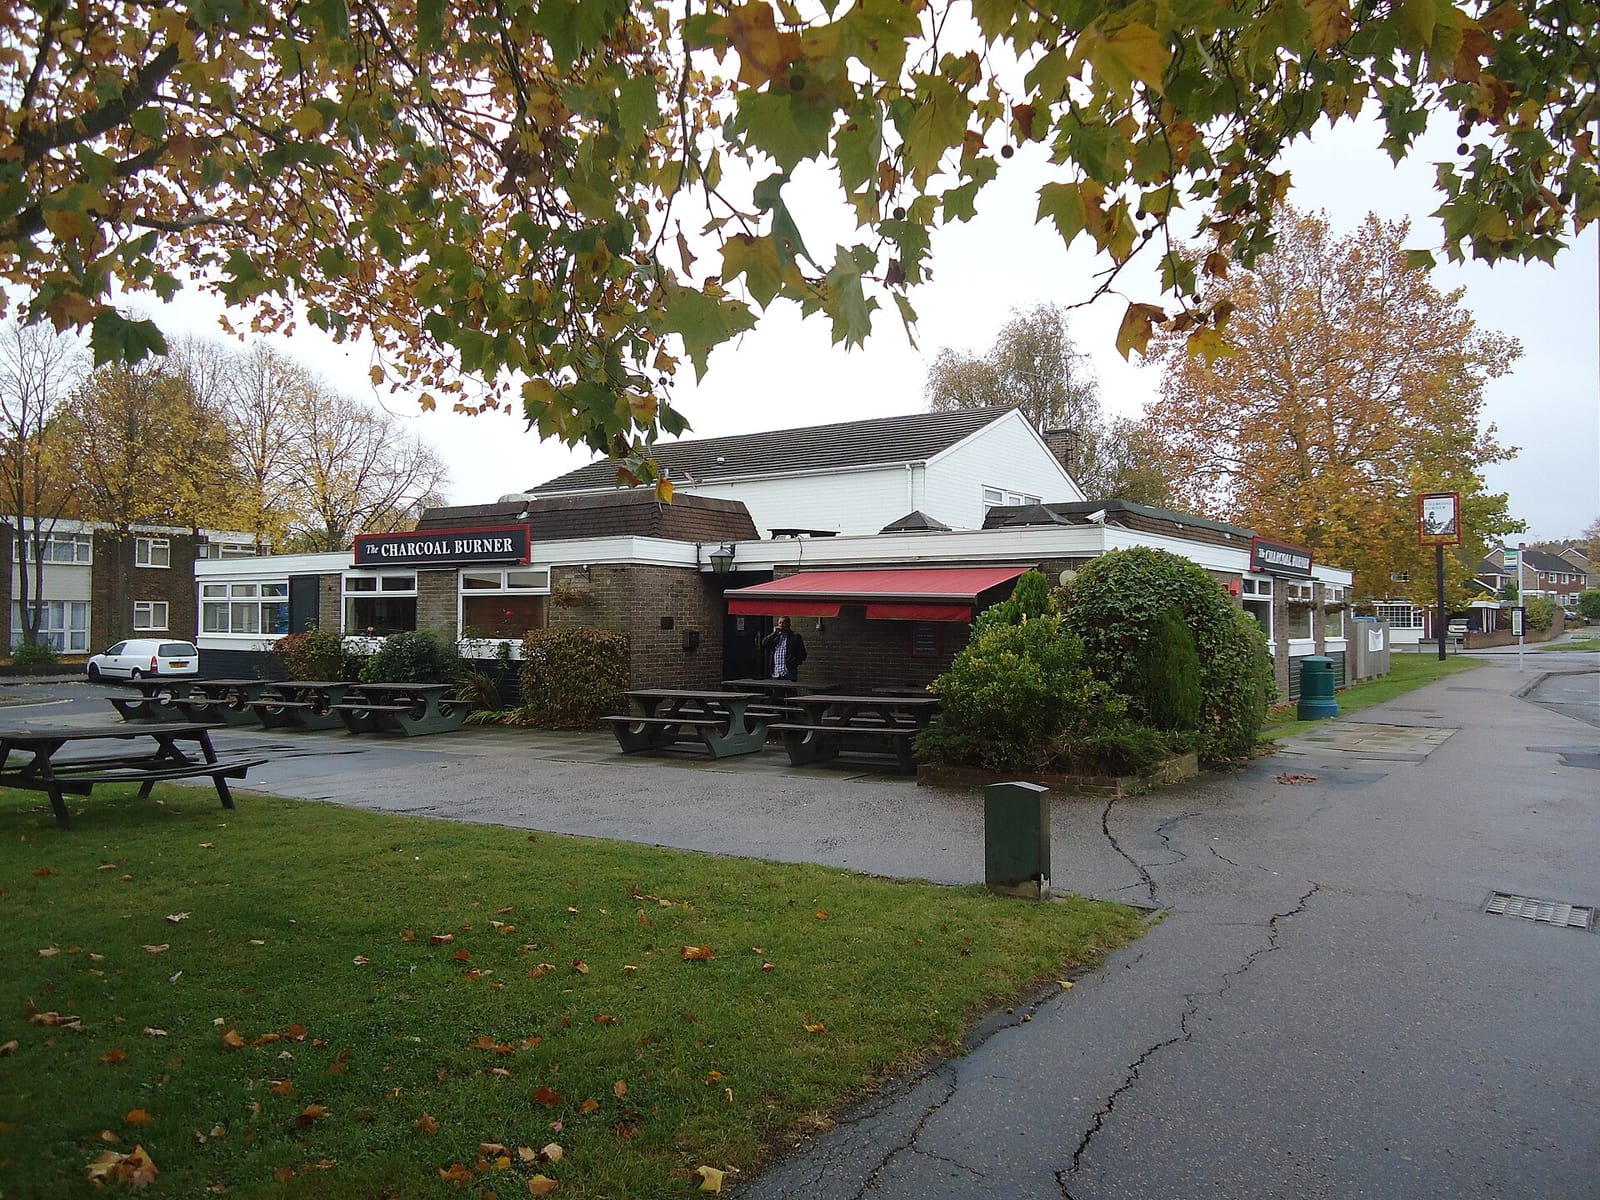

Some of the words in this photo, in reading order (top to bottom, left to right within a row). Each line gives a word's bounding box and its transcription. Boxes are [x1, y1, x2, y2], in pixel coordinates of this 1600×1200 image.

[365, 544, 379, 555] The
[381, 540, 451, 557] CHARCOAL
[454, 537, 513, 554] BURNER
